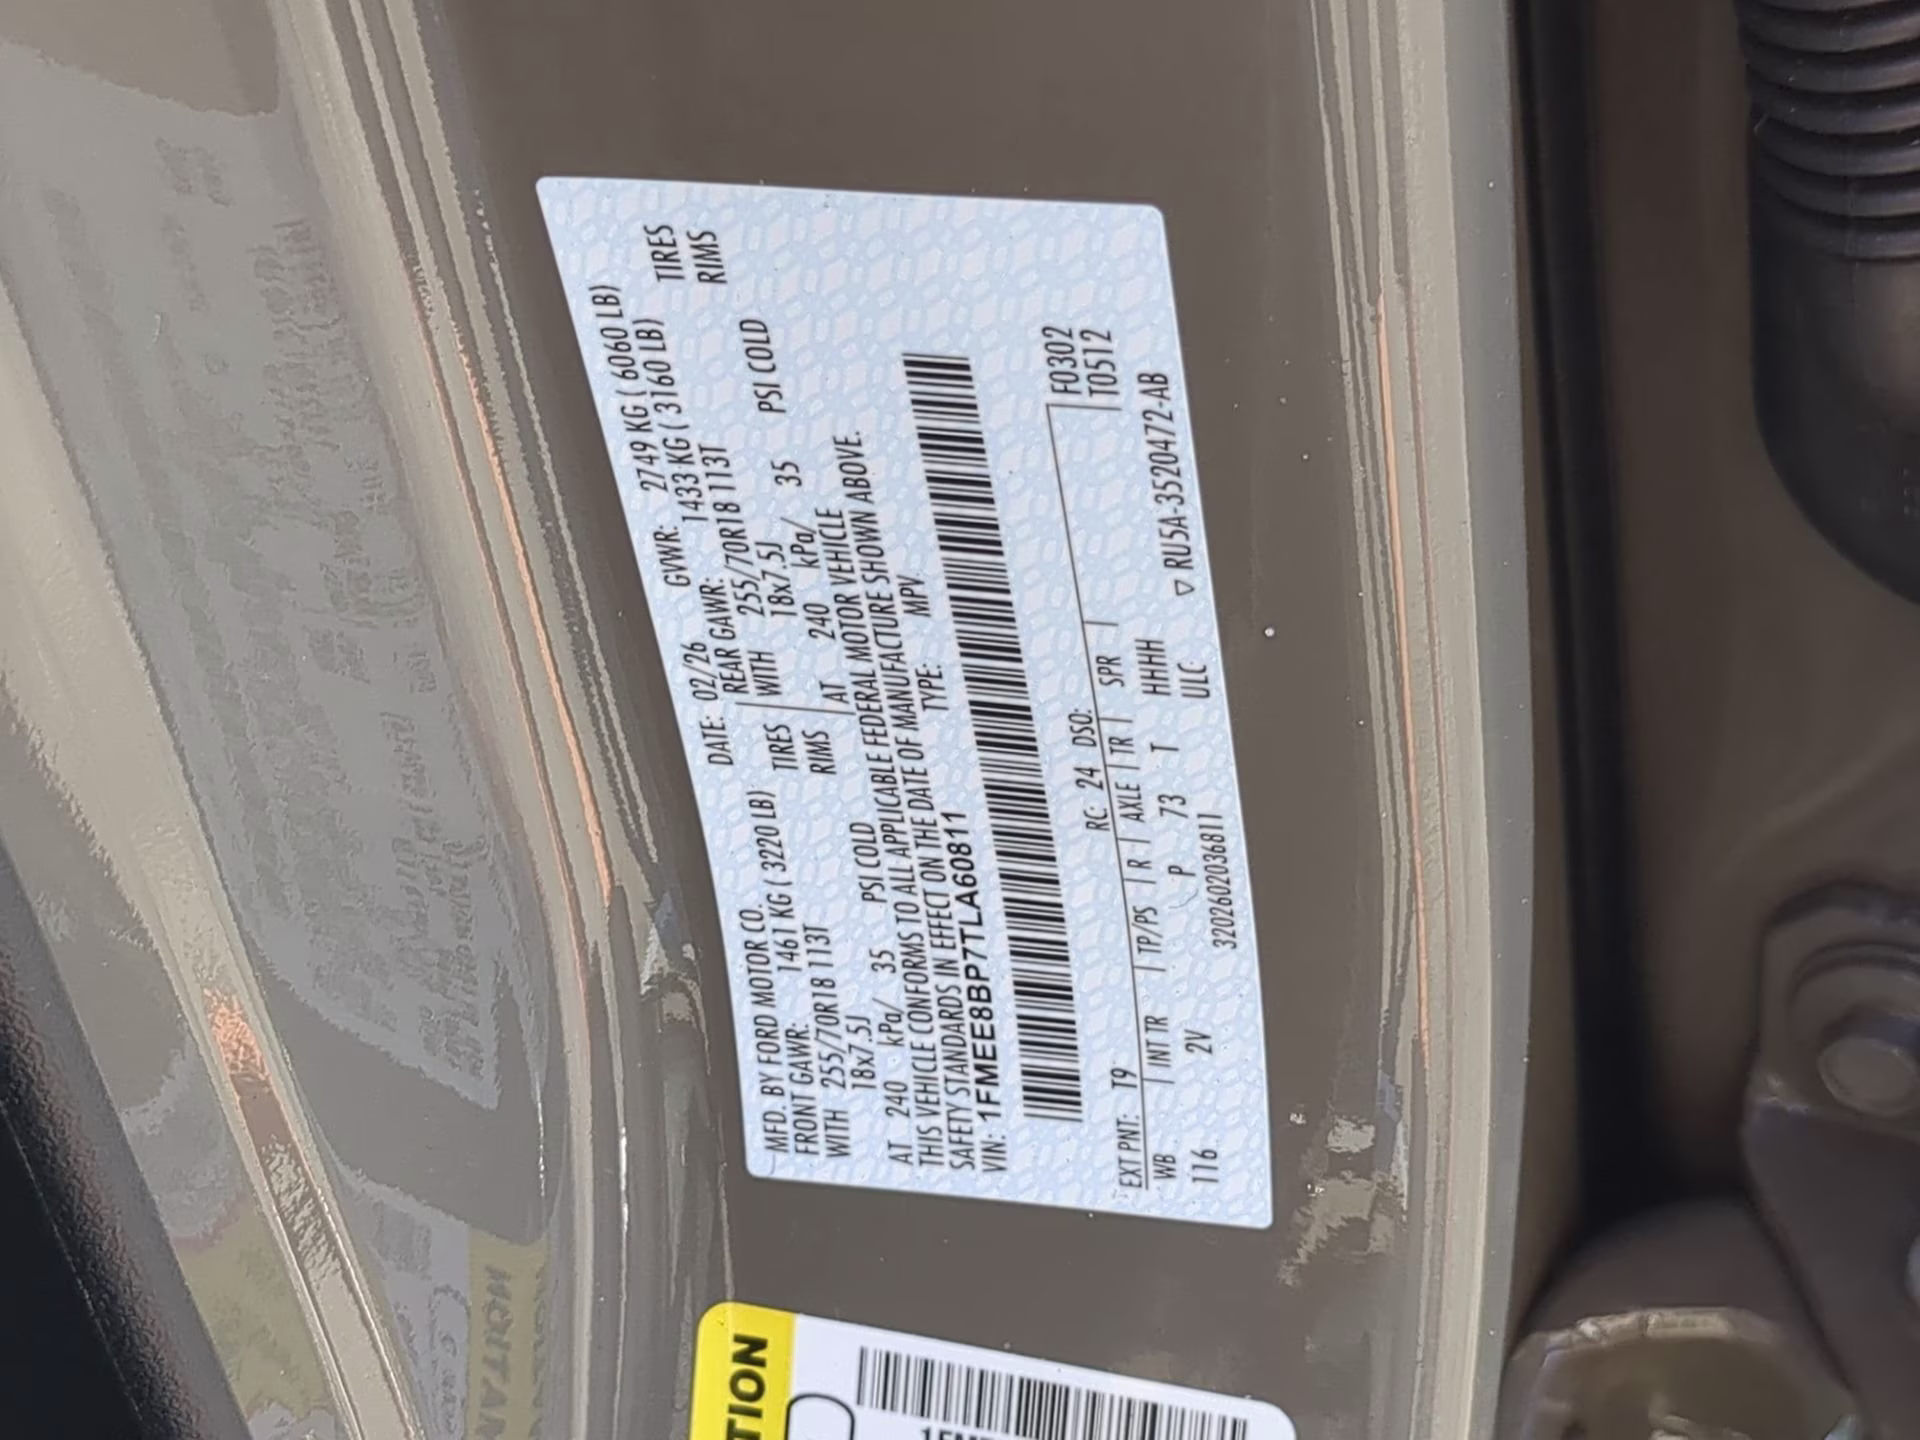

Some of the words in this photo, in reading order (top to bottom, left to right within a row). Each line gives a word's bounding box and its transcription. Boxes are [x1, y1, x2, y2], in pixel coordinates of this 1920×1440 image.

[642, 224, 685, 282] TIRES
[685, 230, 727, 284] RIMS
[587, 284, 624, 318] LB)
[599, 326, 639, 380] 6060
[631, 318, 667, 352] LB)
[738, 318, 776, 373] COLD
[1040, 325, 1082, 394] F0302
[1078, 328, 1120, 397] T0512
[641, 359, 682, 414] 3160
[752, 381, 787, 413] PSI
[619, 404, 653, 433] KG
[628, 440, 668, 492] 2749
[661, 436, 695, 465] KG
[697, 443, 736, 491] 113T
[769, 459, 802, 487] 35
[832, 431, 874, 504] ABOVE.
[1136, 372, 1193, 570] RU5A-3520472-AB
[670, 472, 708, 522] 1433
[652, 524, 691, 587] GVWR:
[711, 501, 765, 617] 255/70R18
[779, 516, 820, 569] kPa/
[813, 507, 857, 586] VEHICLE
[848, 510, 890, 584] SHOWN
[754, 540, 797, 616] 18x7.5J
[895, 574, 931, 617] MPV
[698, 577, 736, 640] GAWR:
[801, 602, 836, 640] 240
[832, 592, 873, 662] MOTOR
[679, 641, 718, 701] 02/26
[713, 647, 749, 694] REAR
[746, 650, 782, 696] WITH
[864, 590, 919, 731] MANUFACTURE
[1095, 654, 1125, 687] SPR
[1134, 638, 1171, 696] HHHH
[1176, 662, 1210, 699] ULC
[818, 680, 849, 704] AT
[848, 669, 890, 747] FEDERAL
[914, 663, 949, 711] TYPE:
[698, 715, 734, 765] DATE:
[762, 723, 799, 770] TIRES
[893, 736, 924, 760] OF
[1067, 708, 1097, 747] DSO:
[1107, 735, 1134, 755] TR
[1149, 741, 1179, 752] T
[800, 729, 837, 775] RIMS
[899, 765, 934, 811] DATE
[1073, 766, 1104, 790] 24
[745, 790, 776, 819] LB)
[864, 752, 911, 859] APPLICABLE
[1082, 806, 1110, 831] RC:
[1114, 781, 1145, 823] AXLE
[1156, 793, 1188, 818] 73
[753, 824, 786, 872] 3220
[848, 821, 881, 868] COLD
[909, 816, 941, 849] THE
[887, 865, 918, 896] ALL
[917, 855, 947, 883] ON
[1126, 858, 1152, 869] R
[1167, 864, 1196, 876] P
[1196, 813, 1237, 949] 3202602036811
[765, 892, 794, 919] KG
[857, 875, 887, 903] PSI
[737, 903, 766, 933] CO.
[892, 901, 921, 924] TO
[922, 887, 957, 950] EFFECT
[1131, 905, 1162, 954] TP/PS
[771, 927, 802, 972] 1461
[801, 922, 833, 968] 113T
[868, 948, 896, 973] 35
[931, 957, 960, 977] IN
[939, 811, 1001, 1122] 1FMEE8BP7TLA60811
[743, 939, 776, 1008] MOTOR
[896, 931, 934, 1034] CONFORMS
[752, 1013, 782, 1065] FORD
[809, 976, 846, 1089] 255/70R18
[871, 997, 904, 1047] kPa/
[934, 984, 971, 1096] STANDARDS
[1143, 1015, 1168, 1033] TR
[1183, 1028, 1212, 1054] 2V
[784, 1022, 814, 1085] GAWR:
[844, 1014, 876, 1089] 18x7.5J
[1145, 1038, 1170, 1067] INT
[758, 1071, 785, 1096] BY
[882, 1080, 910, 1118] 240
[909, 1041, 941, 1117] VEHICLE
[1109, 1067, 1137, 1089] T9
[761, 1106, 789, 1153] MFD.
[789, 1091, 819, 1155] FRONT
[823, 1108, 850, 1158] WITH
[915, 1125, 944, 1166] THIS
[945, 1101, 975, 1170] SAFETY
[1115, 1114, 1140, 1152] PNT:
[887, 1139, 913, 1165] AT
[980, 1133, 1007, 1172] VIN:
[1117, 1155, 1142, 1188] EXT
[1152, 1153, 1176, 1179] WB
[1190, 1148, 1219, 1183] 116
